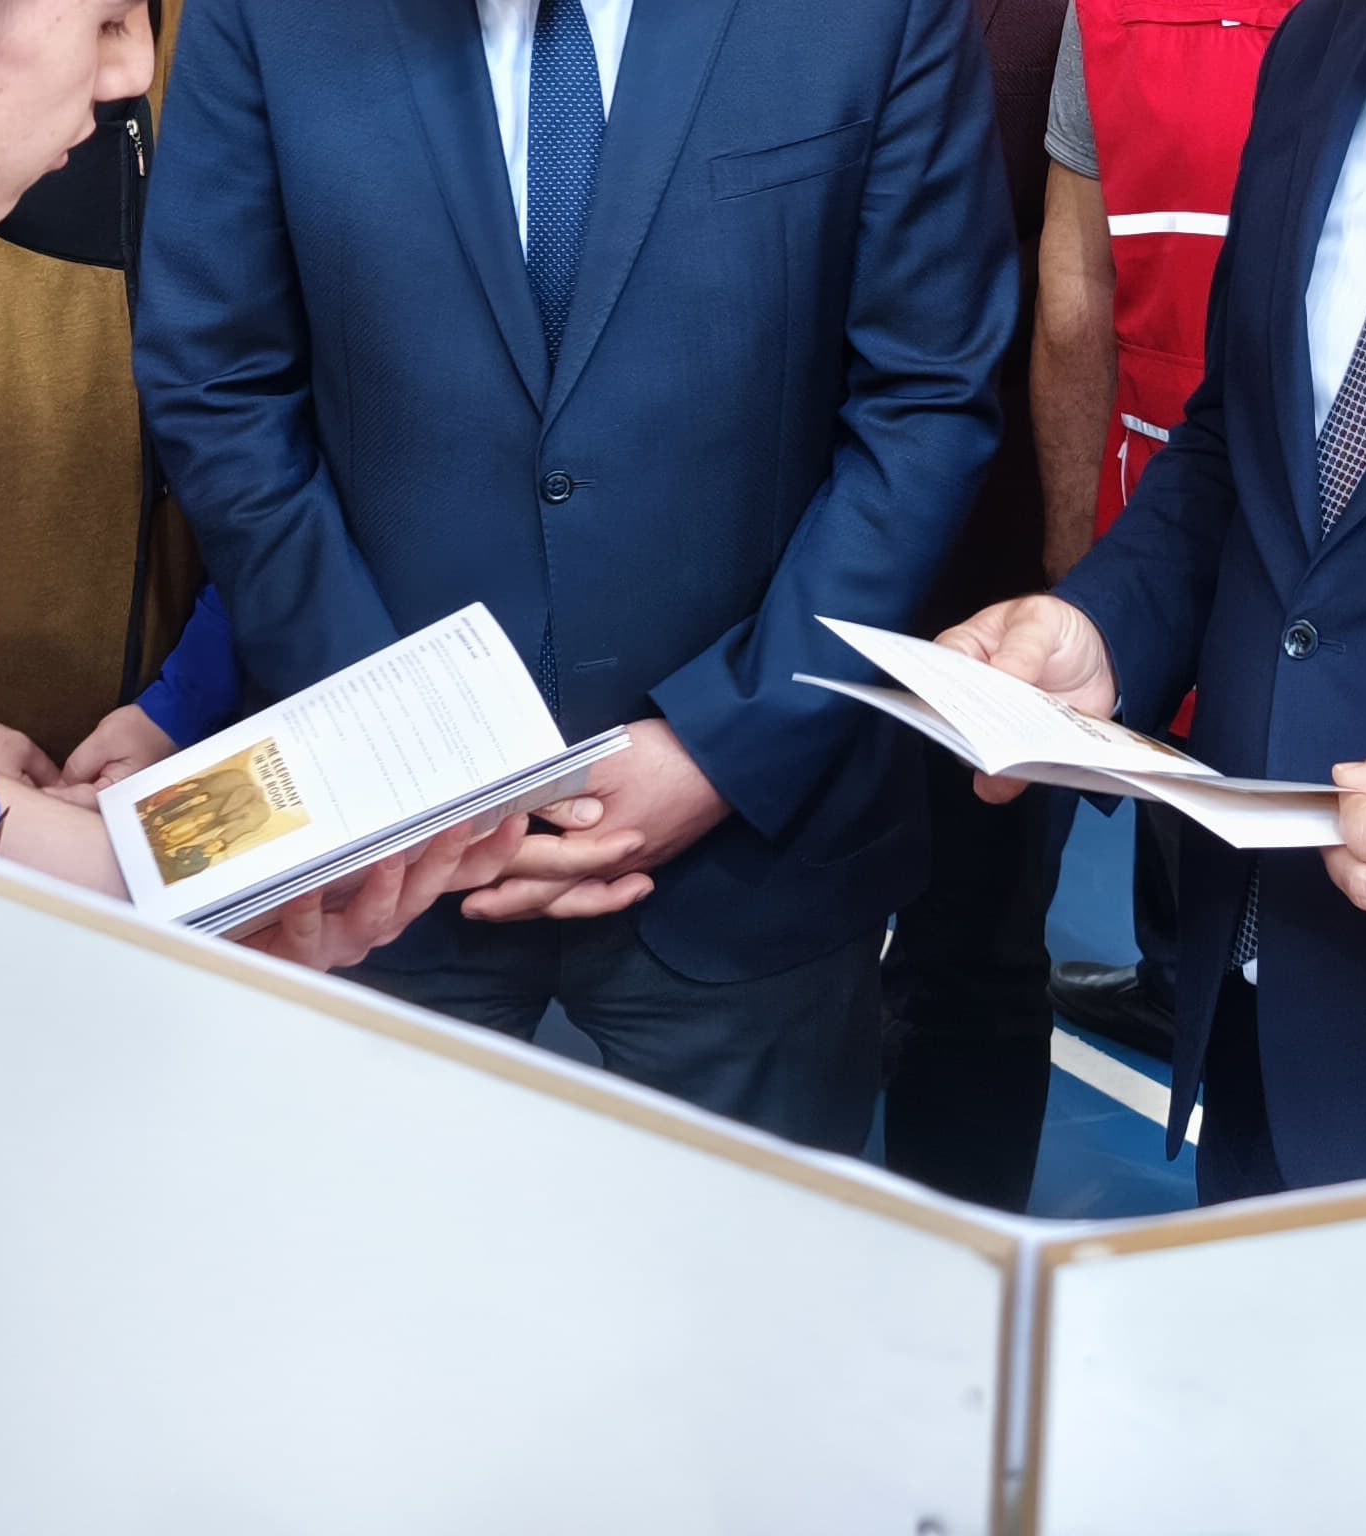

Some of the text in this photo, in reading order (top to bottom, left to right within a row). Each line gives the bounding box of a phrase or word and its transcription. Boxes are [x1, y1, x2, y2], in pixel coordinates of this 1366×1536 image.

[257, 763, 274, 781] THE
[265, 742, 304, 807] THE ELEPHANT
[265, 780, 287, 811] ROOM
